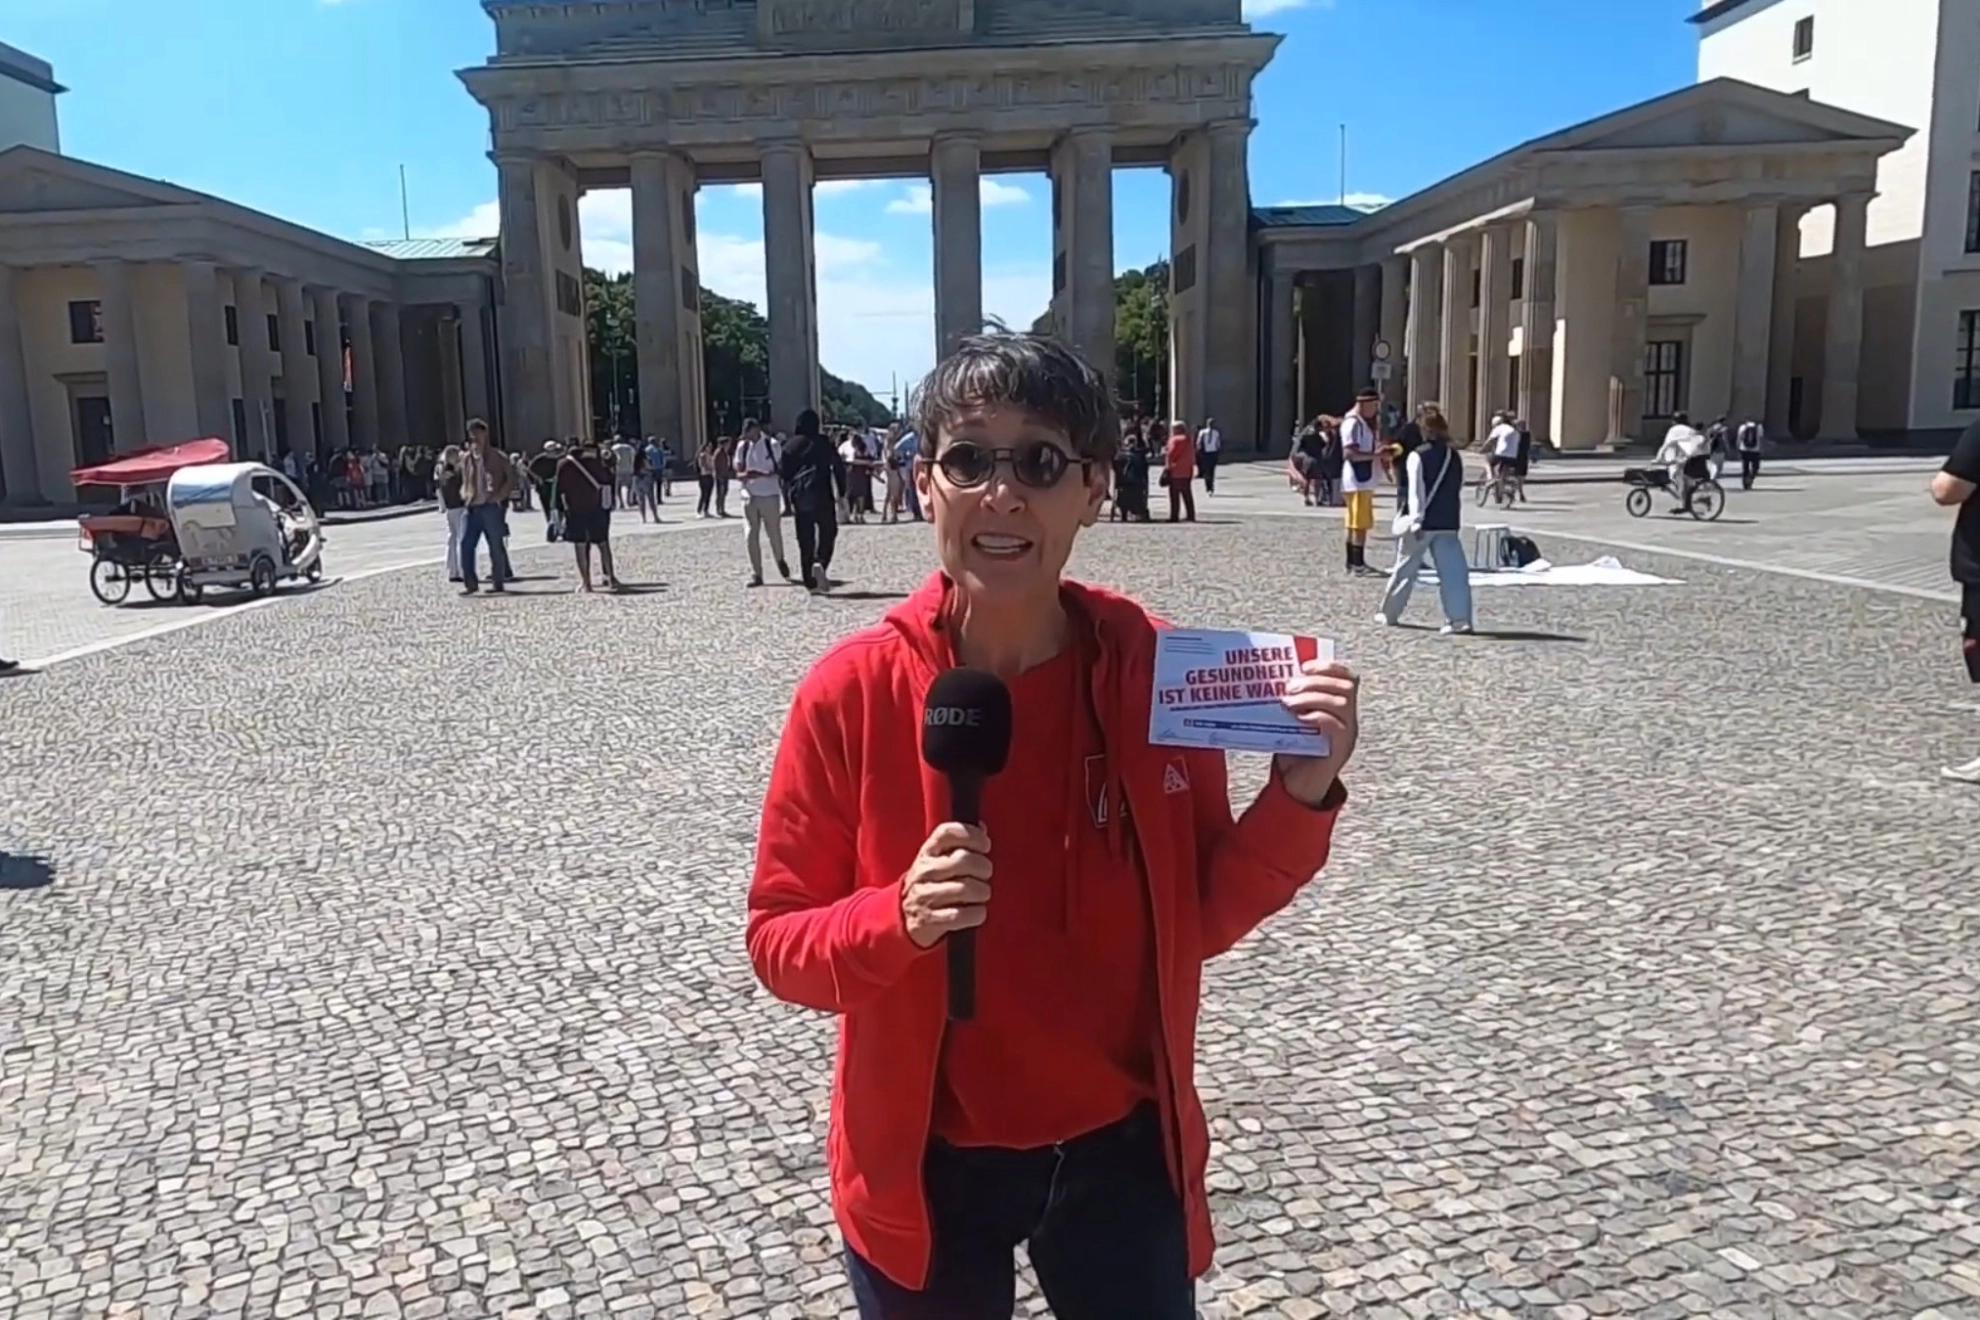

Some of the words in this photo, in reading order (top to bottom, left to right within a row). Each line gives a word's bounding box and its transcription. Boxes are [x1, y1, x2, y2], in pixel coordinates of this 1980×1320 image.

[1225, 646, 1294, 665] UNSERE
[1186, 664, 1295, 685] GESUNDHEIT
[1159, 689, 1185, 704] IST
[1190, 684, 1242, 702] KEINE
[1245, 681, 1288, 698] WAR
[924, 707, 981, 726] RØDE
